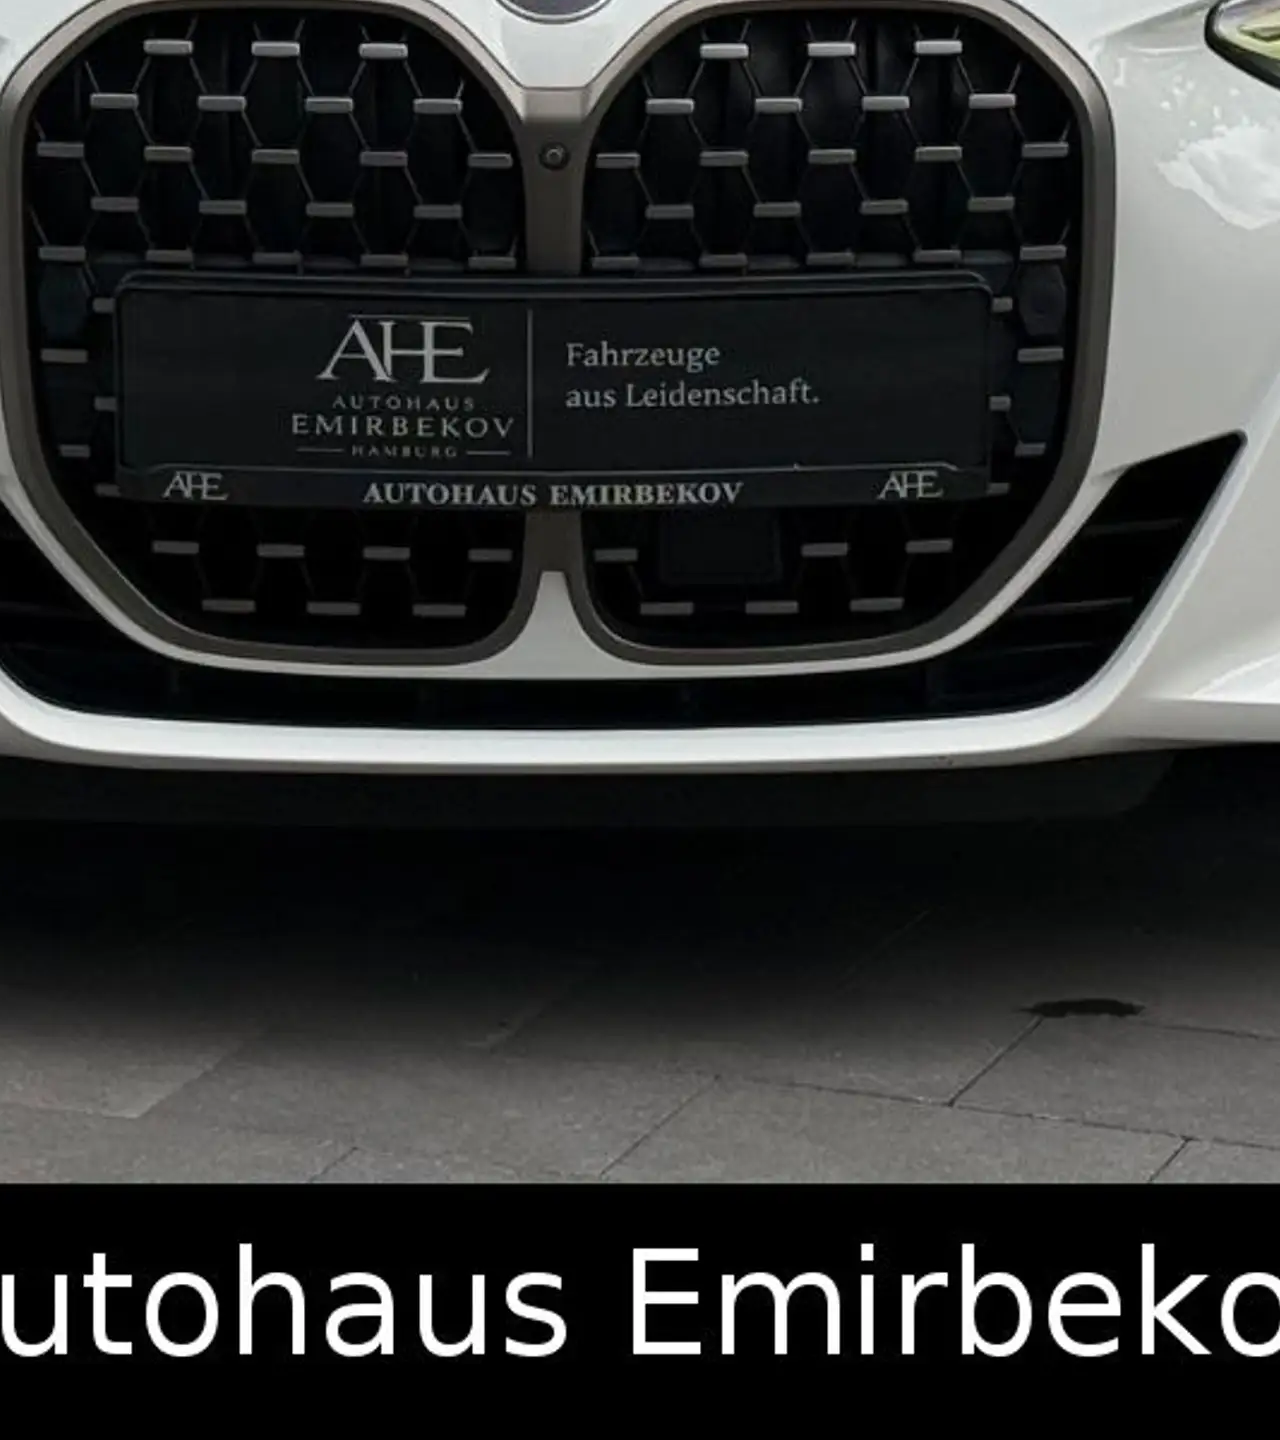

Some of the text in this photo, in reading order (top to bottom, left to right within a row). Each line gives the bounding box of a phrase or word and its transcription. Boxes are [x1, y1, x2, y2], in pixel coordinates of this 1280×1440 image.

[315, 319, 491, 384] AHE
[565, 340, 721, 373] Fahrzeuge
[332, 395, 476, 412] AUTOHAUS
[565, 377, 820, 408] aus Leidenschaft.
[291, 413, 515, 438] EMIRBEKOV
[351, 444, 458, 458] HAMBURG
[362, 481, 745, 506] AUTOHAUS EMIRBEKOV
